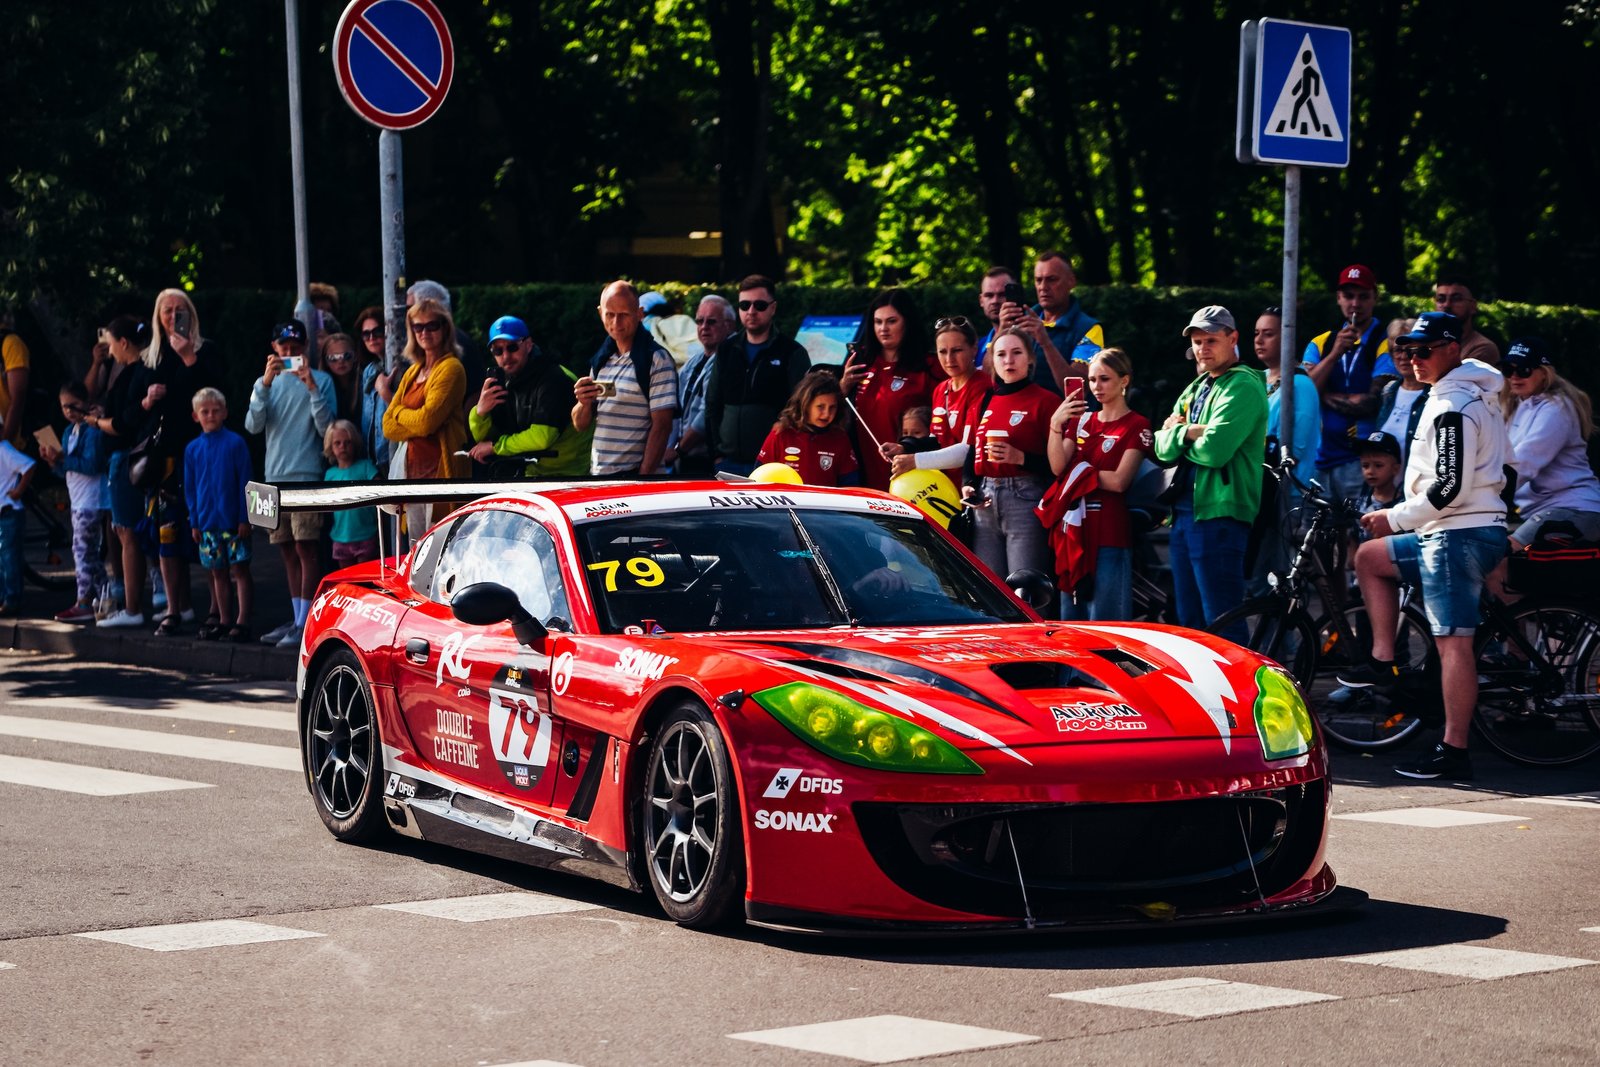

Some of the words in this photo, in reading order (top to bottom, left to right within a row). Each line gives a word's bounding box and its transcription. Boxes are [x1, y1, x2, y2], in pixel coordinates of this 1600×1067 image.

[1448, 426, 1456, 444] NEW
[1448, 446, 1456, 467] YORK
[585, 502, 630, 513] AURUM
[708, 492, 797, 510] AURUM
[587, 556, 665, 593] 79
[329, 594, 398, 630] AUTOVESTA
[435, 631, 484, 689] RC
[615, 646, 680, 681] SONAX
[457, 686, 472, 698] cola
[1050, 702, 1142, 720] AURUM
[436, 708, 474, 740] DOUBLE
[498, 695, 541, 761] 79
[433, 735, 480, 769] CAFFEINE
[398, 781, 416, 798] DFDS
[800, 776, 843, 795] DFDS
[754, 809, 834, 834] SONAX
